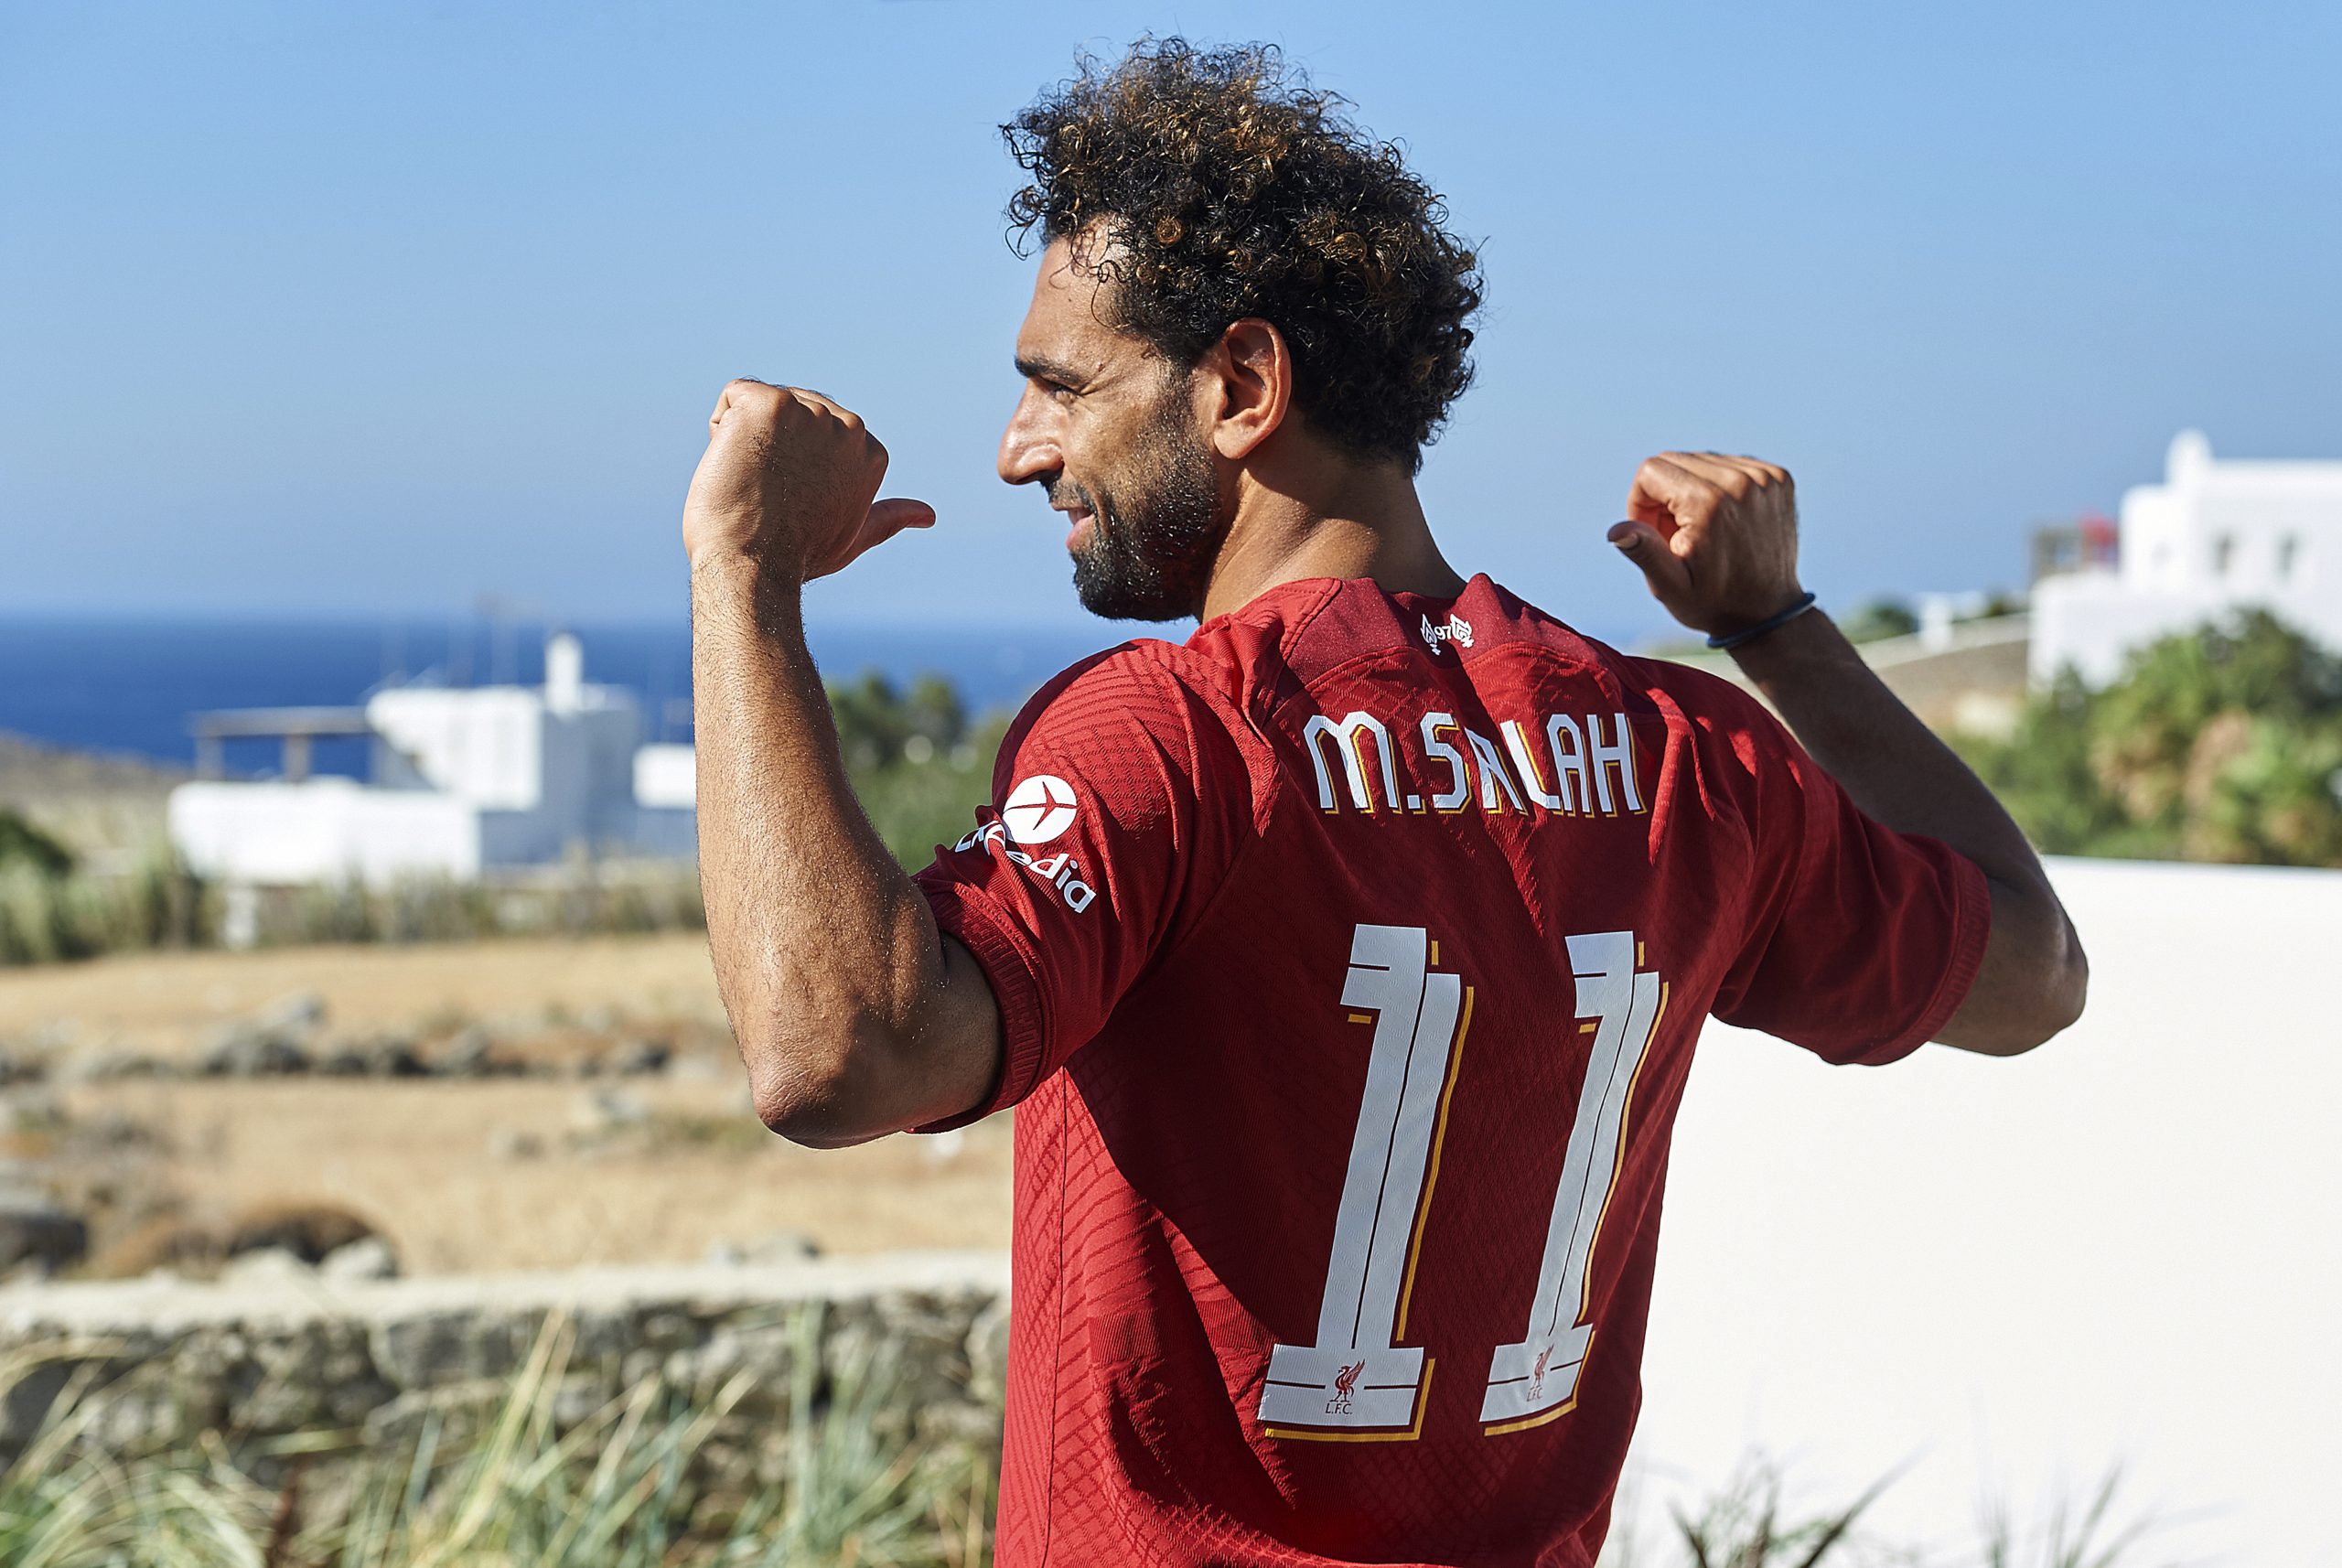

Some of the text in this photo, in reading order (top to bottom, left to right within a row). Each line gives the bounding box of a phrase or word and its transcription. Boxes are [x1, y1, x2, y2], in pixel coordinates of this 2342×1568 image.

[1434, 626, 1452, 640] 97
[1259, 923, 1670, 1441] 11
[1325, 1402, 1353, 1414] L.F.C.
